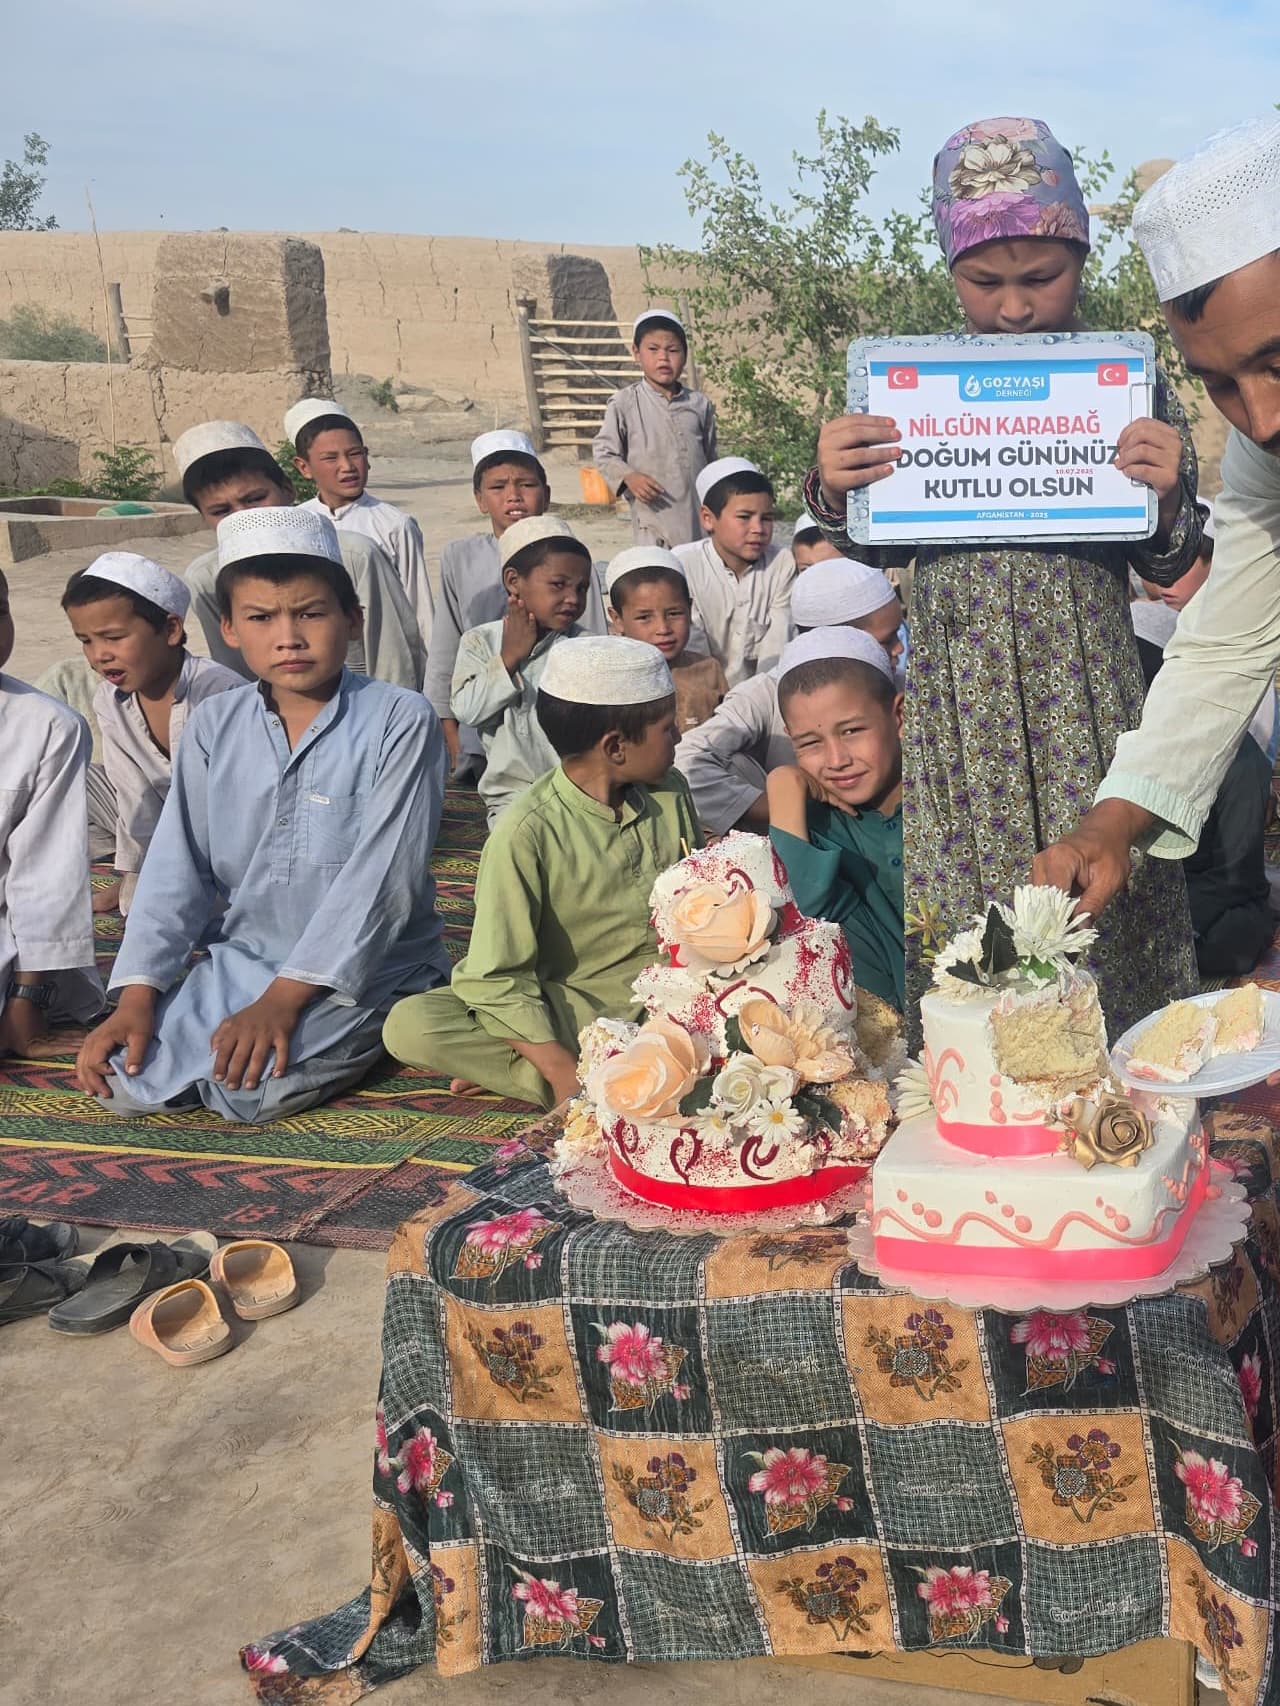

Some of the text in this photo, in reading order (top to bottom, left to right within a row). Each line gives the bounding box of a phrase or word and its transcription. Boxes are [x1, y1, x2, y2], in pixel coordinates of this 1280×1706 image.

[909, 409, 1100, 437] NİLGÜN KARABAĞ
[896, 439, 1121, 468] DOĞUM GÜNÜNÜZ
[924, 476, 1094, 499] KUTLU OLSUN
